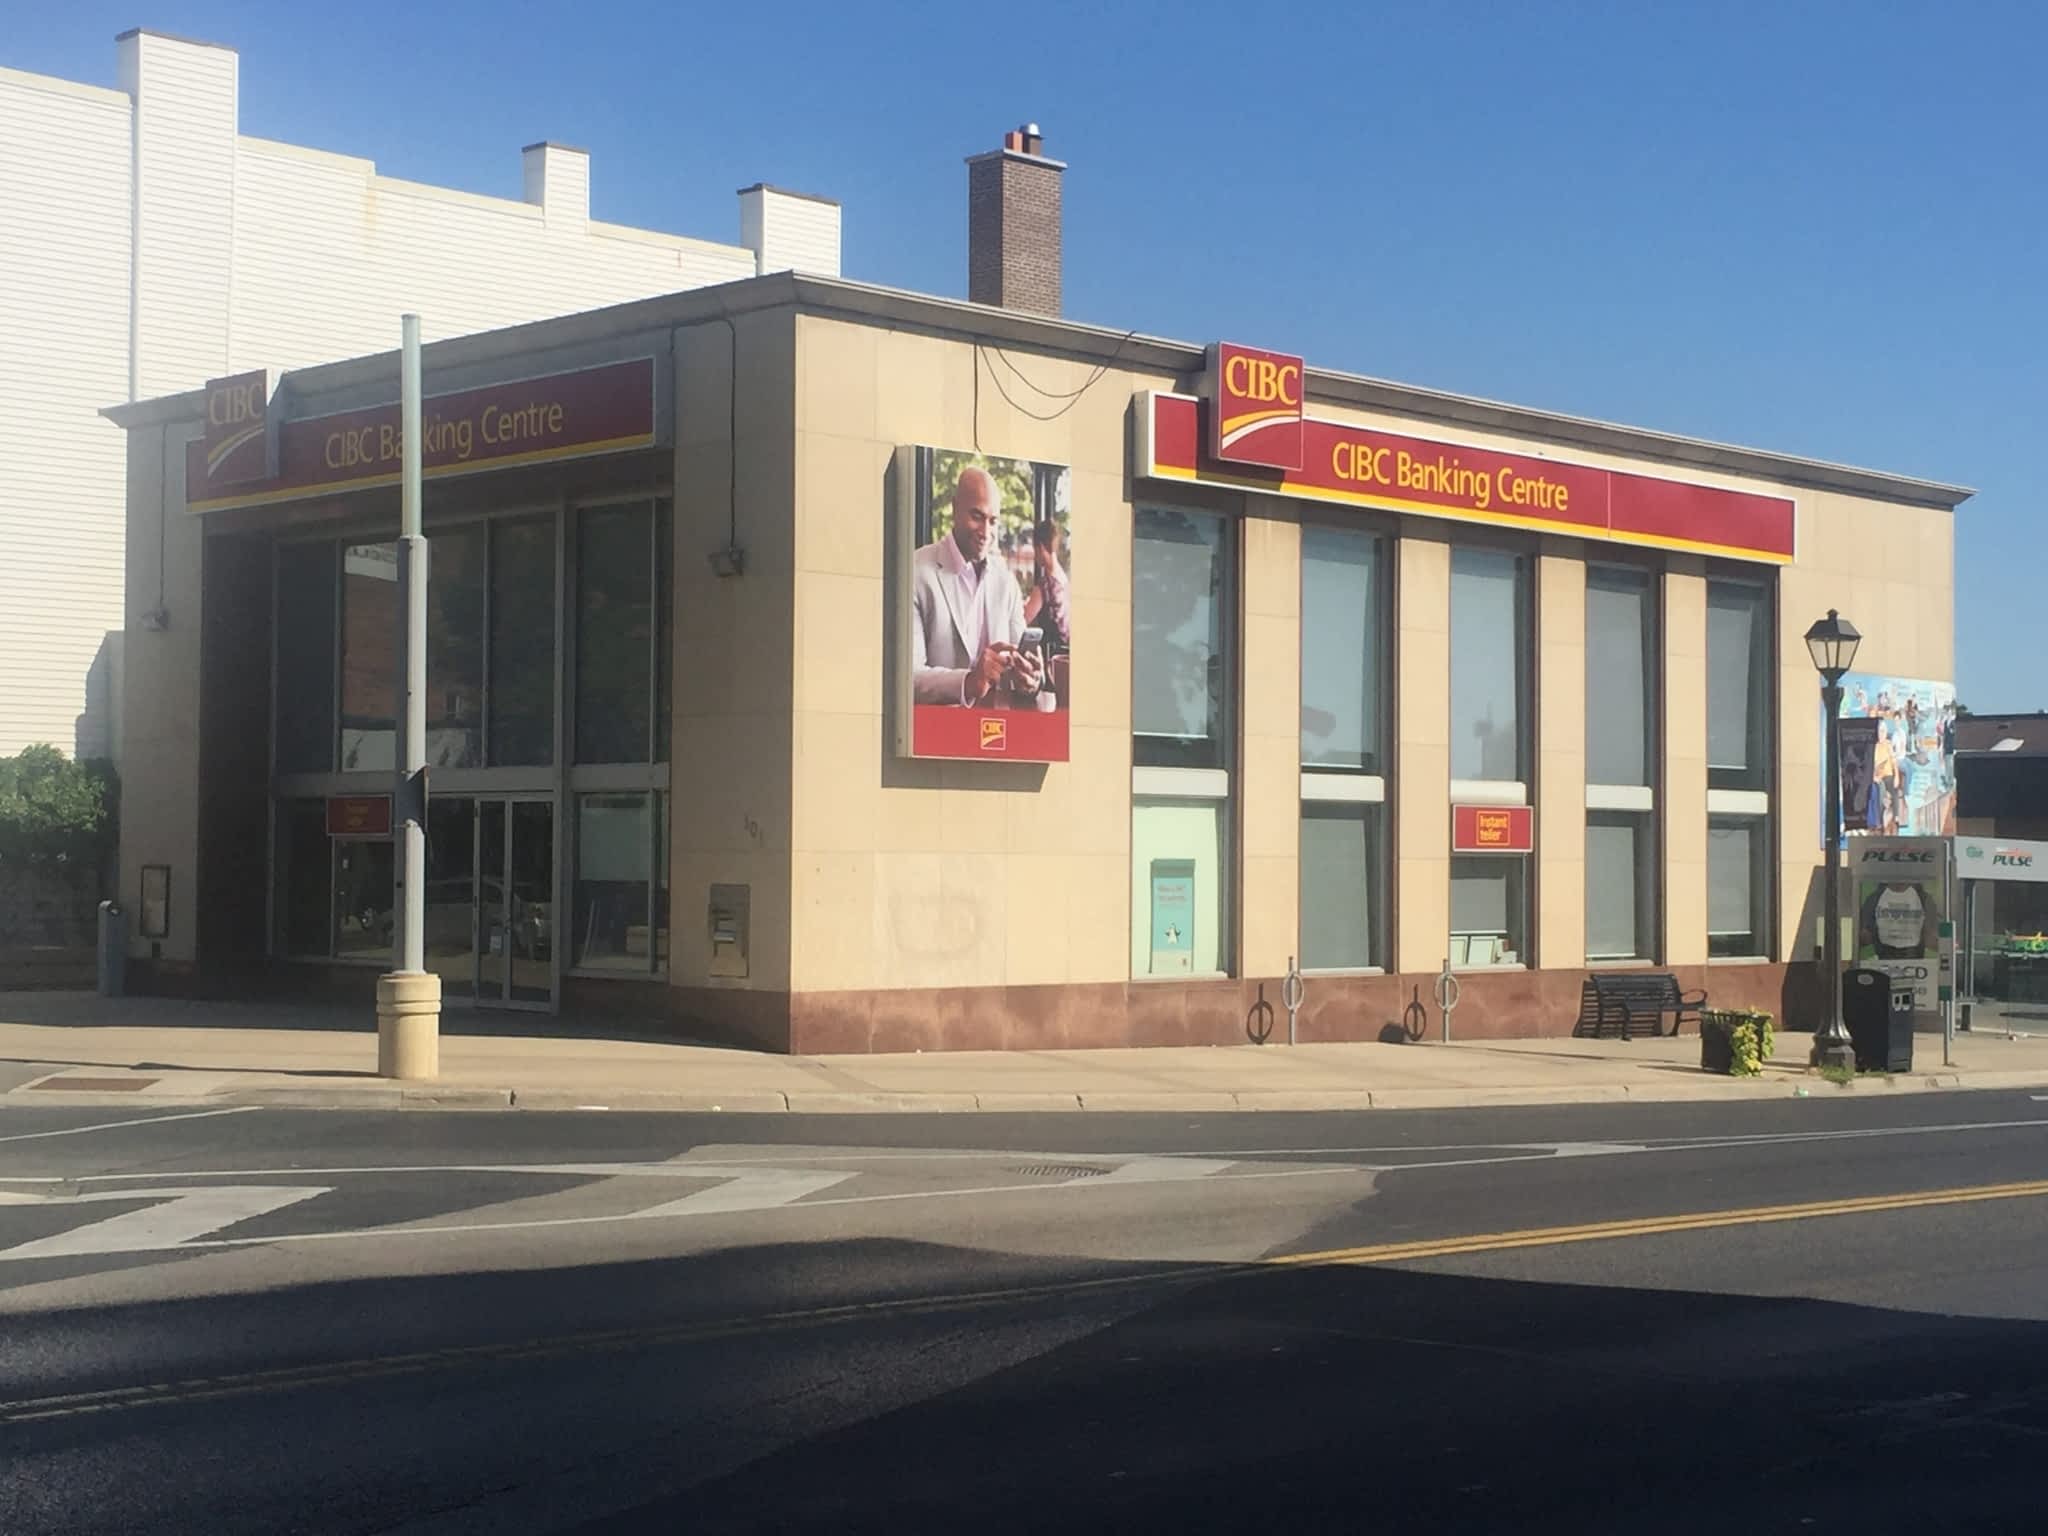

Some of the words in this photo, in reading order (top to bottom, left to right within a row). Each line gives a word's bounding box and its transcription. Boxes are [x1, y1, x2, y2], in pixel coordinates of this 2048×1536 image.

[209, 383, 264, 425] CIBC
[1226, 356, 1298, 406] CIBC
[326, 427, 373, 468] CIBC
[380, 412, 473, 459] Baking
[481, 402, 564, 444] Centre
[1333, 442, 1391, 485] CIBC
[1397, 451, 1491, 508] Banking
[1496, 467, 1569, 511] Centre
[1861, 851, 1936, 863] PULSE
[1992, 854, 2033, 867] PULSE
